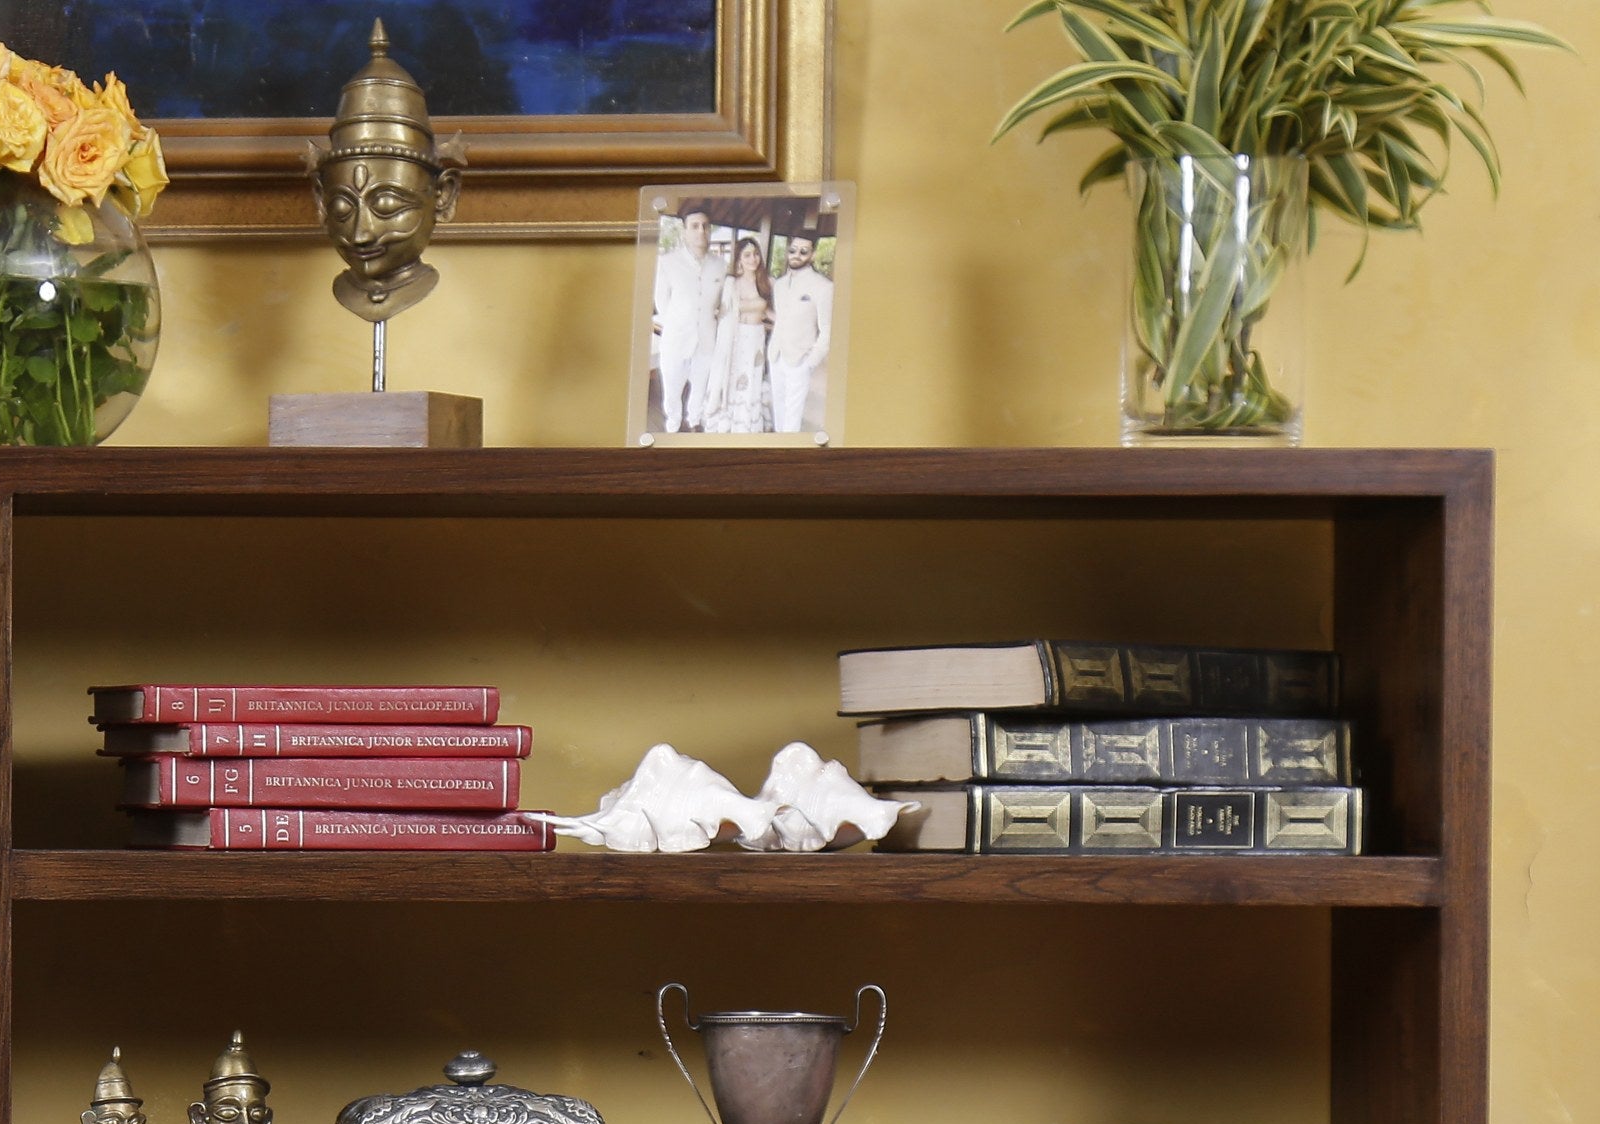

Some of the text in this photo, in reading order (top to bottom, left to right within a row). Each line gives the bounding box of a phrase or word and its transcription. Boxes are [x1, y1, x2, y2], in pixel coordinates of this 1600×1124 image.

[171, 701, 185, 710] 8
[248, 701, 324, 711] BRITANNICA
[326, 701, 375, 713] JUNIOR
[215, 736, 230, 744] 7
[253, 734, 266, 747] H
[291, 736, 364, 747] BRITANNICA
[366, 736, 413, 749] JUNIOR
[186, 775, 200, 784] 6
[225, 769, 239, 794] FG
[265, 776, 341, 788] BRITANNICA
[344, 778, 392, 790] JUNIOR
[239, 824, 253, 832] 5
[276, 814, 289, 842] DE
[315, 824, 388, 834] BRITANNICA
[391, 824, 437, 837] JUNIOR
